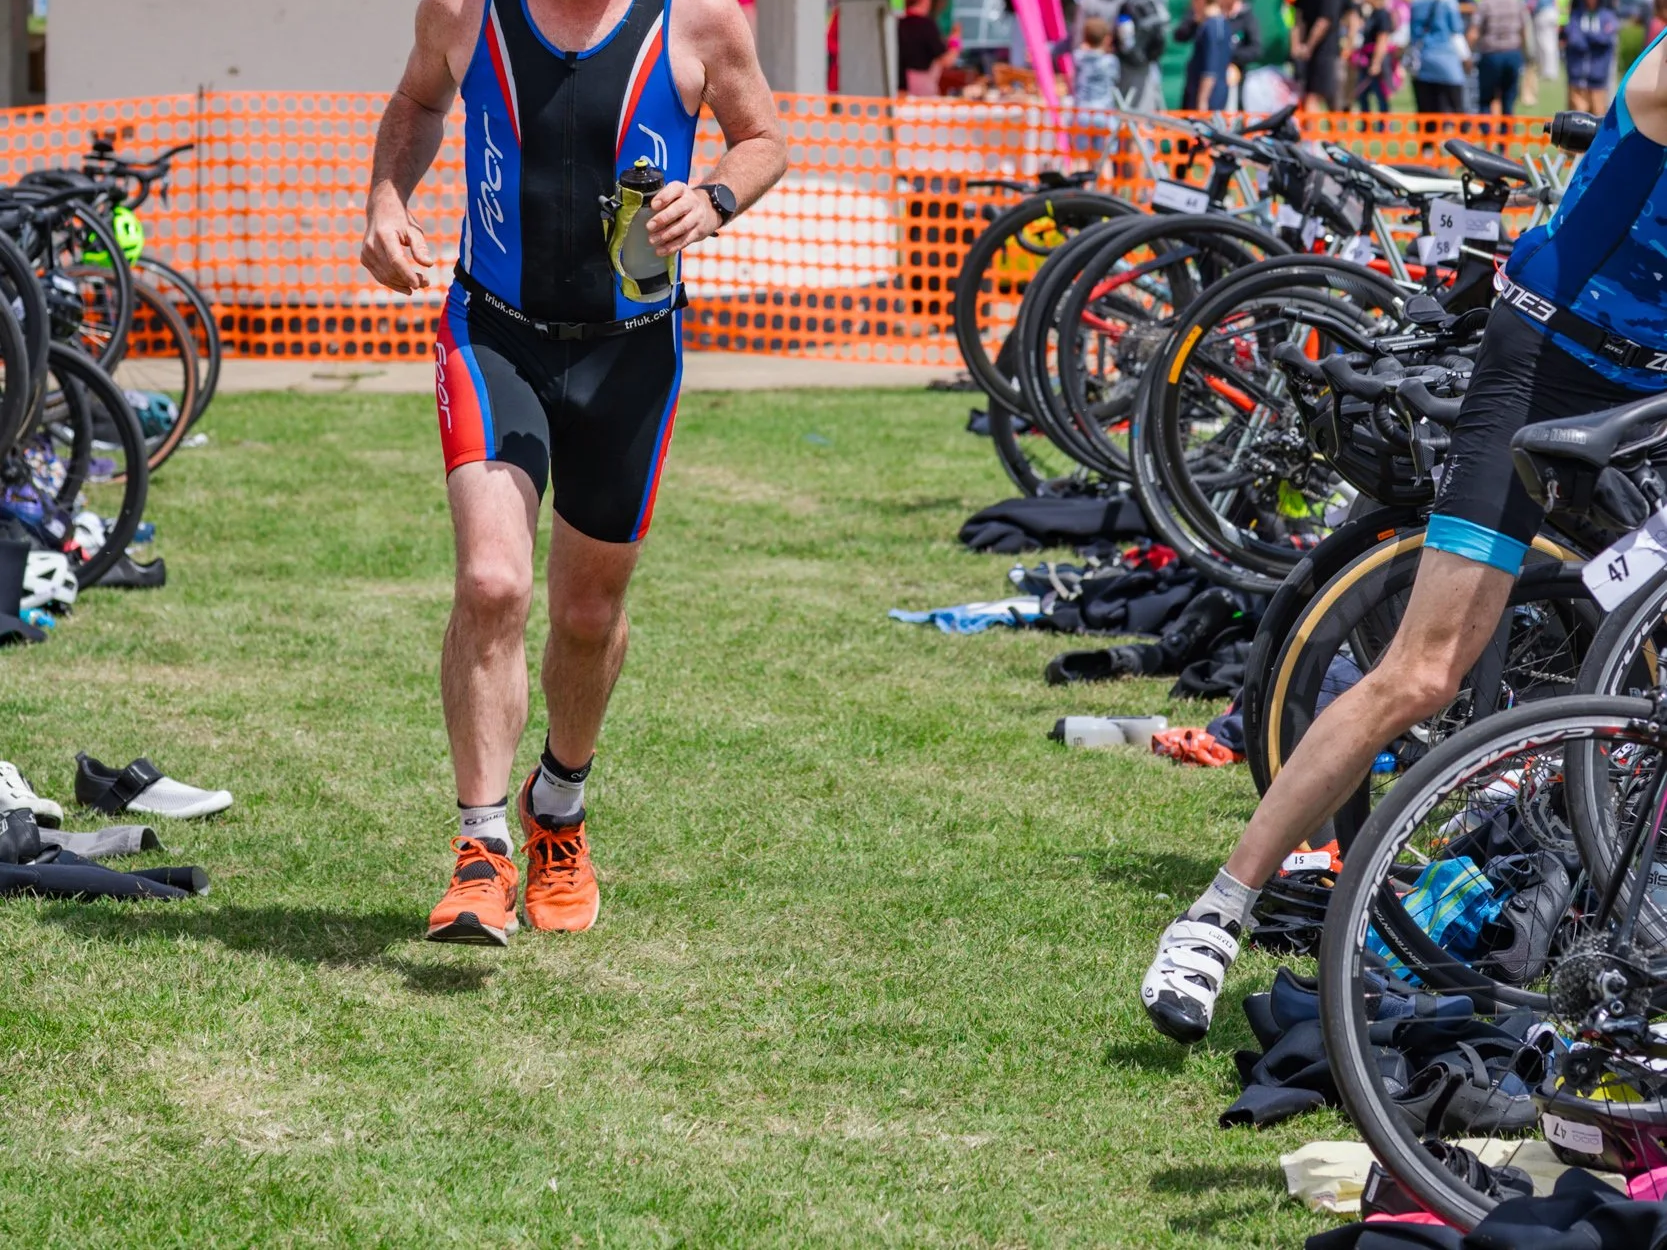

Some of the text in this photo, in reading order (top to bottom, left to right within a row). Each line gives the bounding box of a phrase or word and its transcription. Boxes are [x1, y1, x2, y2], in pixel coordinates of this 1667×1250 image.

[1440, 214, 1453, 228] 56
[1436, 241, 1450, 255] 58
[1606, 554, 1631, 584] 47
[1553, 1122, 1568, 1140] 47
